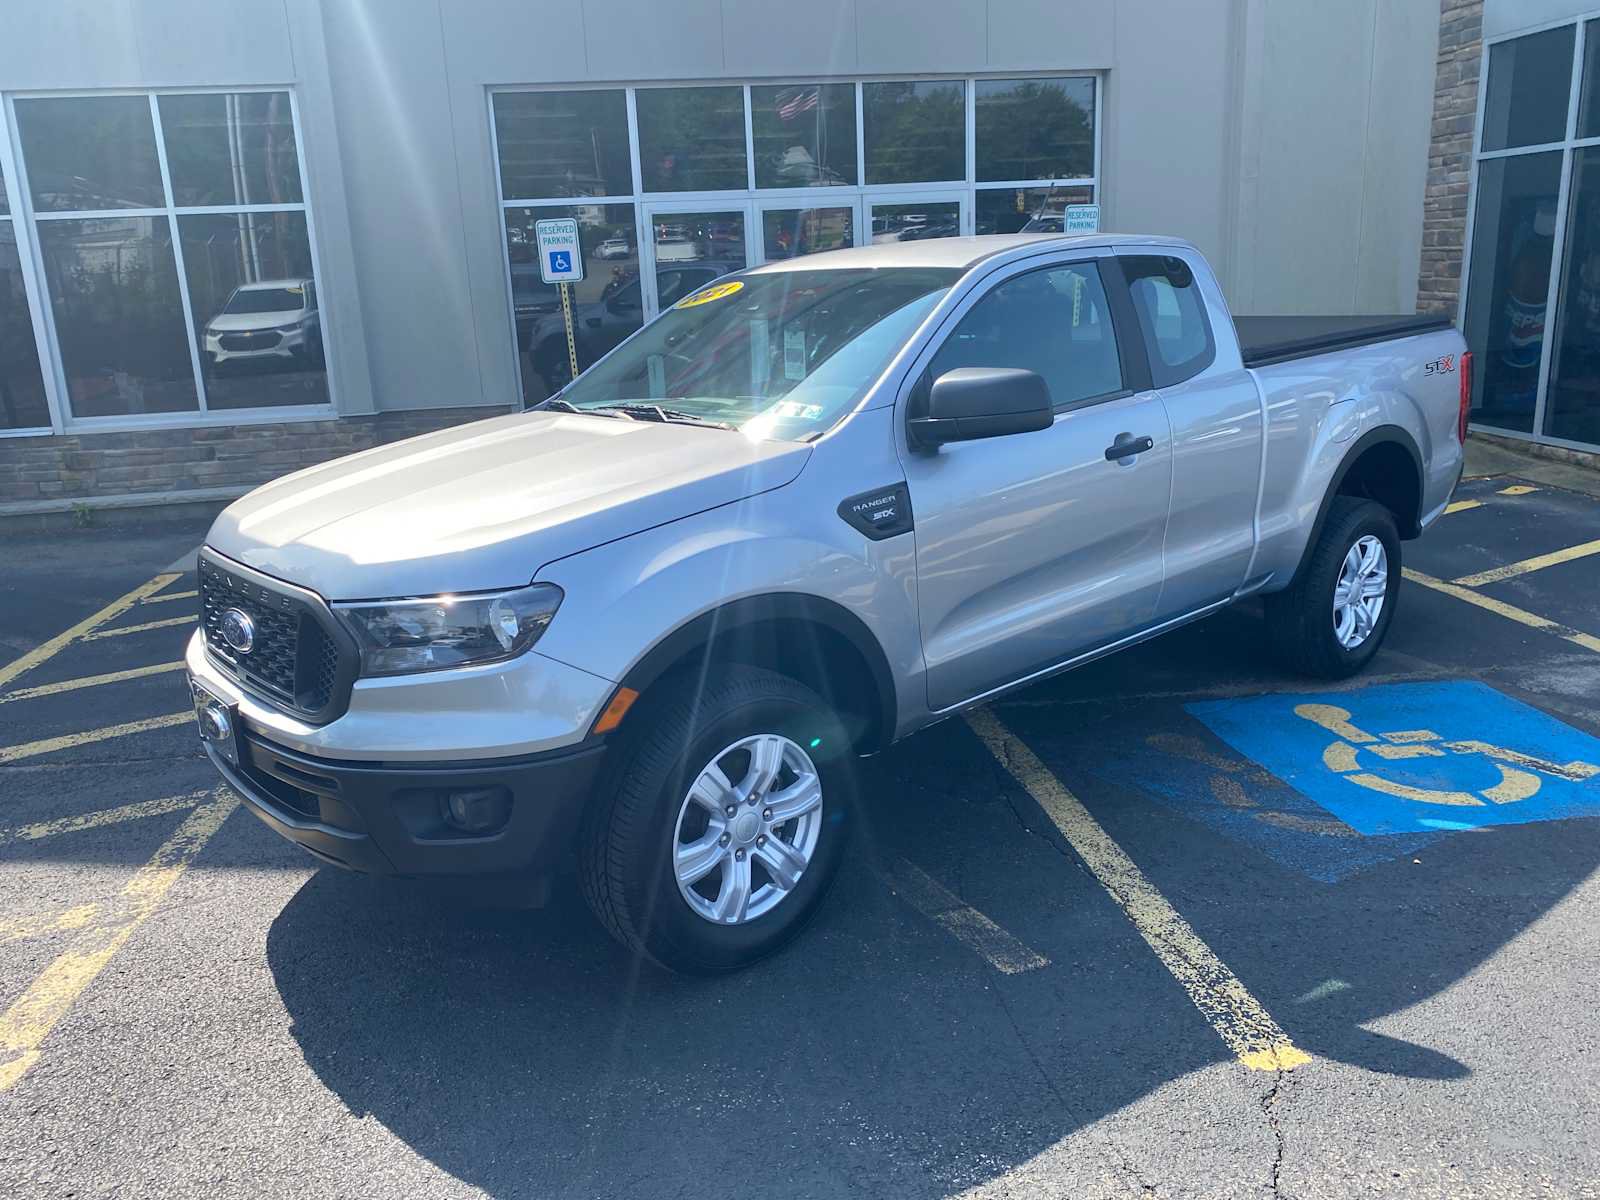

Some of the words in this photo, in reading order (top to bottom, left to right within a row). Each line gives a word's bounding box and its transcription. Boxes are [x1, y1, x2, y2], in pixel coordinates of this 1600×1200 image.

[1069, 210, 1097, 218] RESERVED
[539, 224, 575, 235] RESERVED
[1070, 221, 1095, 230] PARKING
[543, 236, 575, 246] PARKING
[1424, 353, 1456, 376] STX
[853, 495, 896, 512] RANGER
[873, 508, 895, 520] STX
